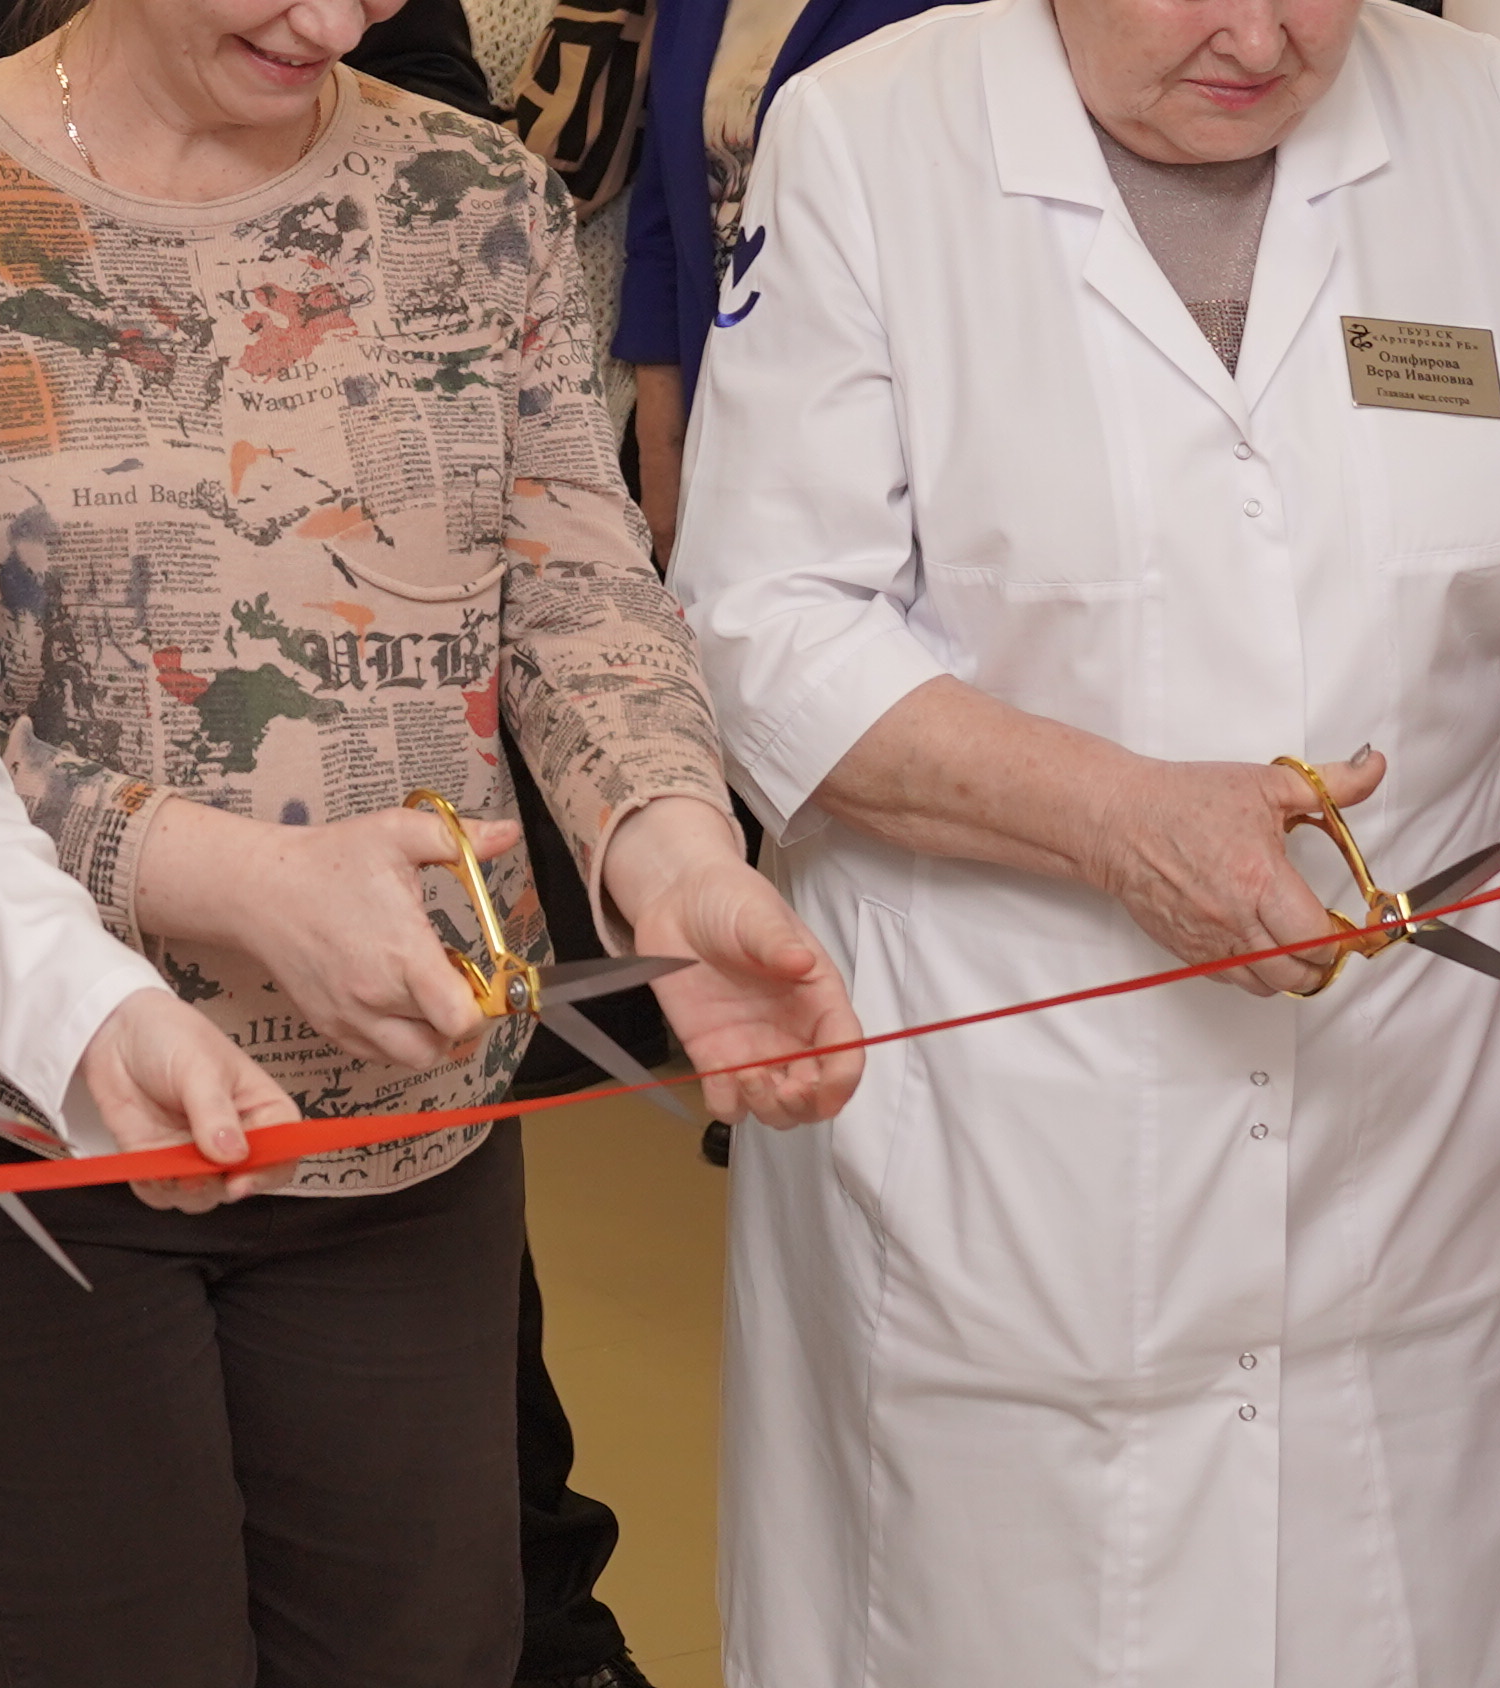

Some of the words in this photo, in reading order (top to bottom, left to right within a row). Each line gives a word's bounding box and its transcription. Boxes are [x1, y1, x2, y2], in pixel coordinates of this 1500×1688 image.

[1398, 326, 1430, 338] ГБУЗ
[1436, 329, 1454, 340] СК
[1379, 350, 1461, 370] Олифирова
[1366, 364, 1401, 380] Вера
[1406, 368, 1474, 386] Ивановна
[72, 484, 138, 508] Hand
